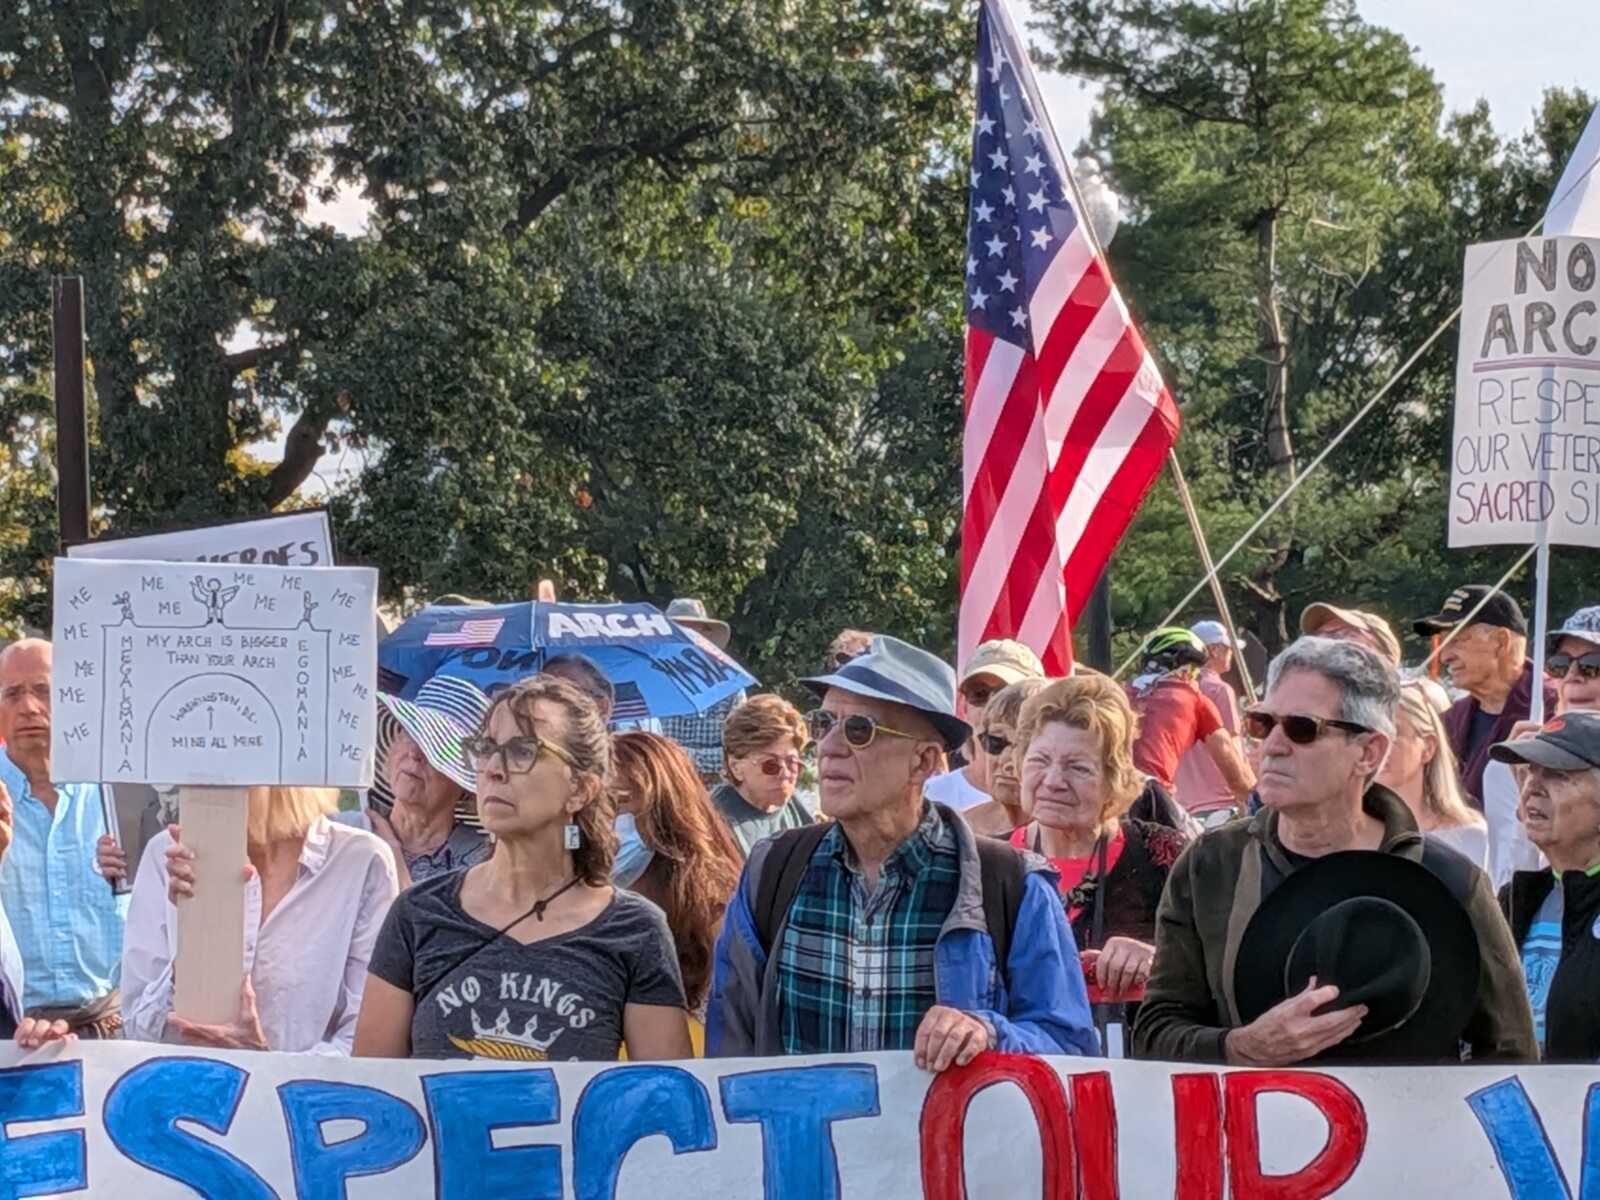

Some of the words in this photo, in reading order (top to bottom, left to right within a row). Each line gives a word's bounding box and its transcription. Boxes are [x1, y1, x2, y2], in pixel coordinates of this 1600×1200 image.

[1514, 238, 1596, 294] NO
[1477, 377, 1600, 427] RESPE
[1456, 433, 1509, 475] OUR
[1521, 432, 1600, 474] VETER
[1456, 480, 1555, 525] SACRED
[196, 541, 319, 566] ROES
[141, 576, 165, 592] ME
[231, 571, 256, 588] ME
[281, 574, 302, 591] ME
[69, 586, 92, 610] ME
[253, 594, 277, 612] ME
[331, 587, 356, 609] ME
[158, 601, 182, 616] ME
[63, 622, 89, 641] ME
[548, 612, 673, 638] ARCH
[146, 635, 171, 648] MY
[177, 635, 212, 648] ARCH
[220, 635, 233, 647] IS
[240, 635, 289, 649] BIGGER
[338, 632, 361, 647] ME
[74, 659, 95, 678] ME
[166, 650, 200, 665] THAN
[206, 653, 235, 667] YOUR
[242, 654, 276, 669] ARCH
[332, 665, 356, 683] ME
[58, 686, 86, 704] ME
[296, 639, 310, 762] EGOMANIA
[352, 682, 368, 700] ME
[118, 635, 134, 774] MEGALOMANIA
[337, 708, 360, 730] ME
[63, 722, 90, 745] ME
[339, 743, 362, 762] ME
[435, 976, 481, 1018] NO
[499, 972, 596, 1029] KINGS
[919, 1052, 1368, 1200] OUR
